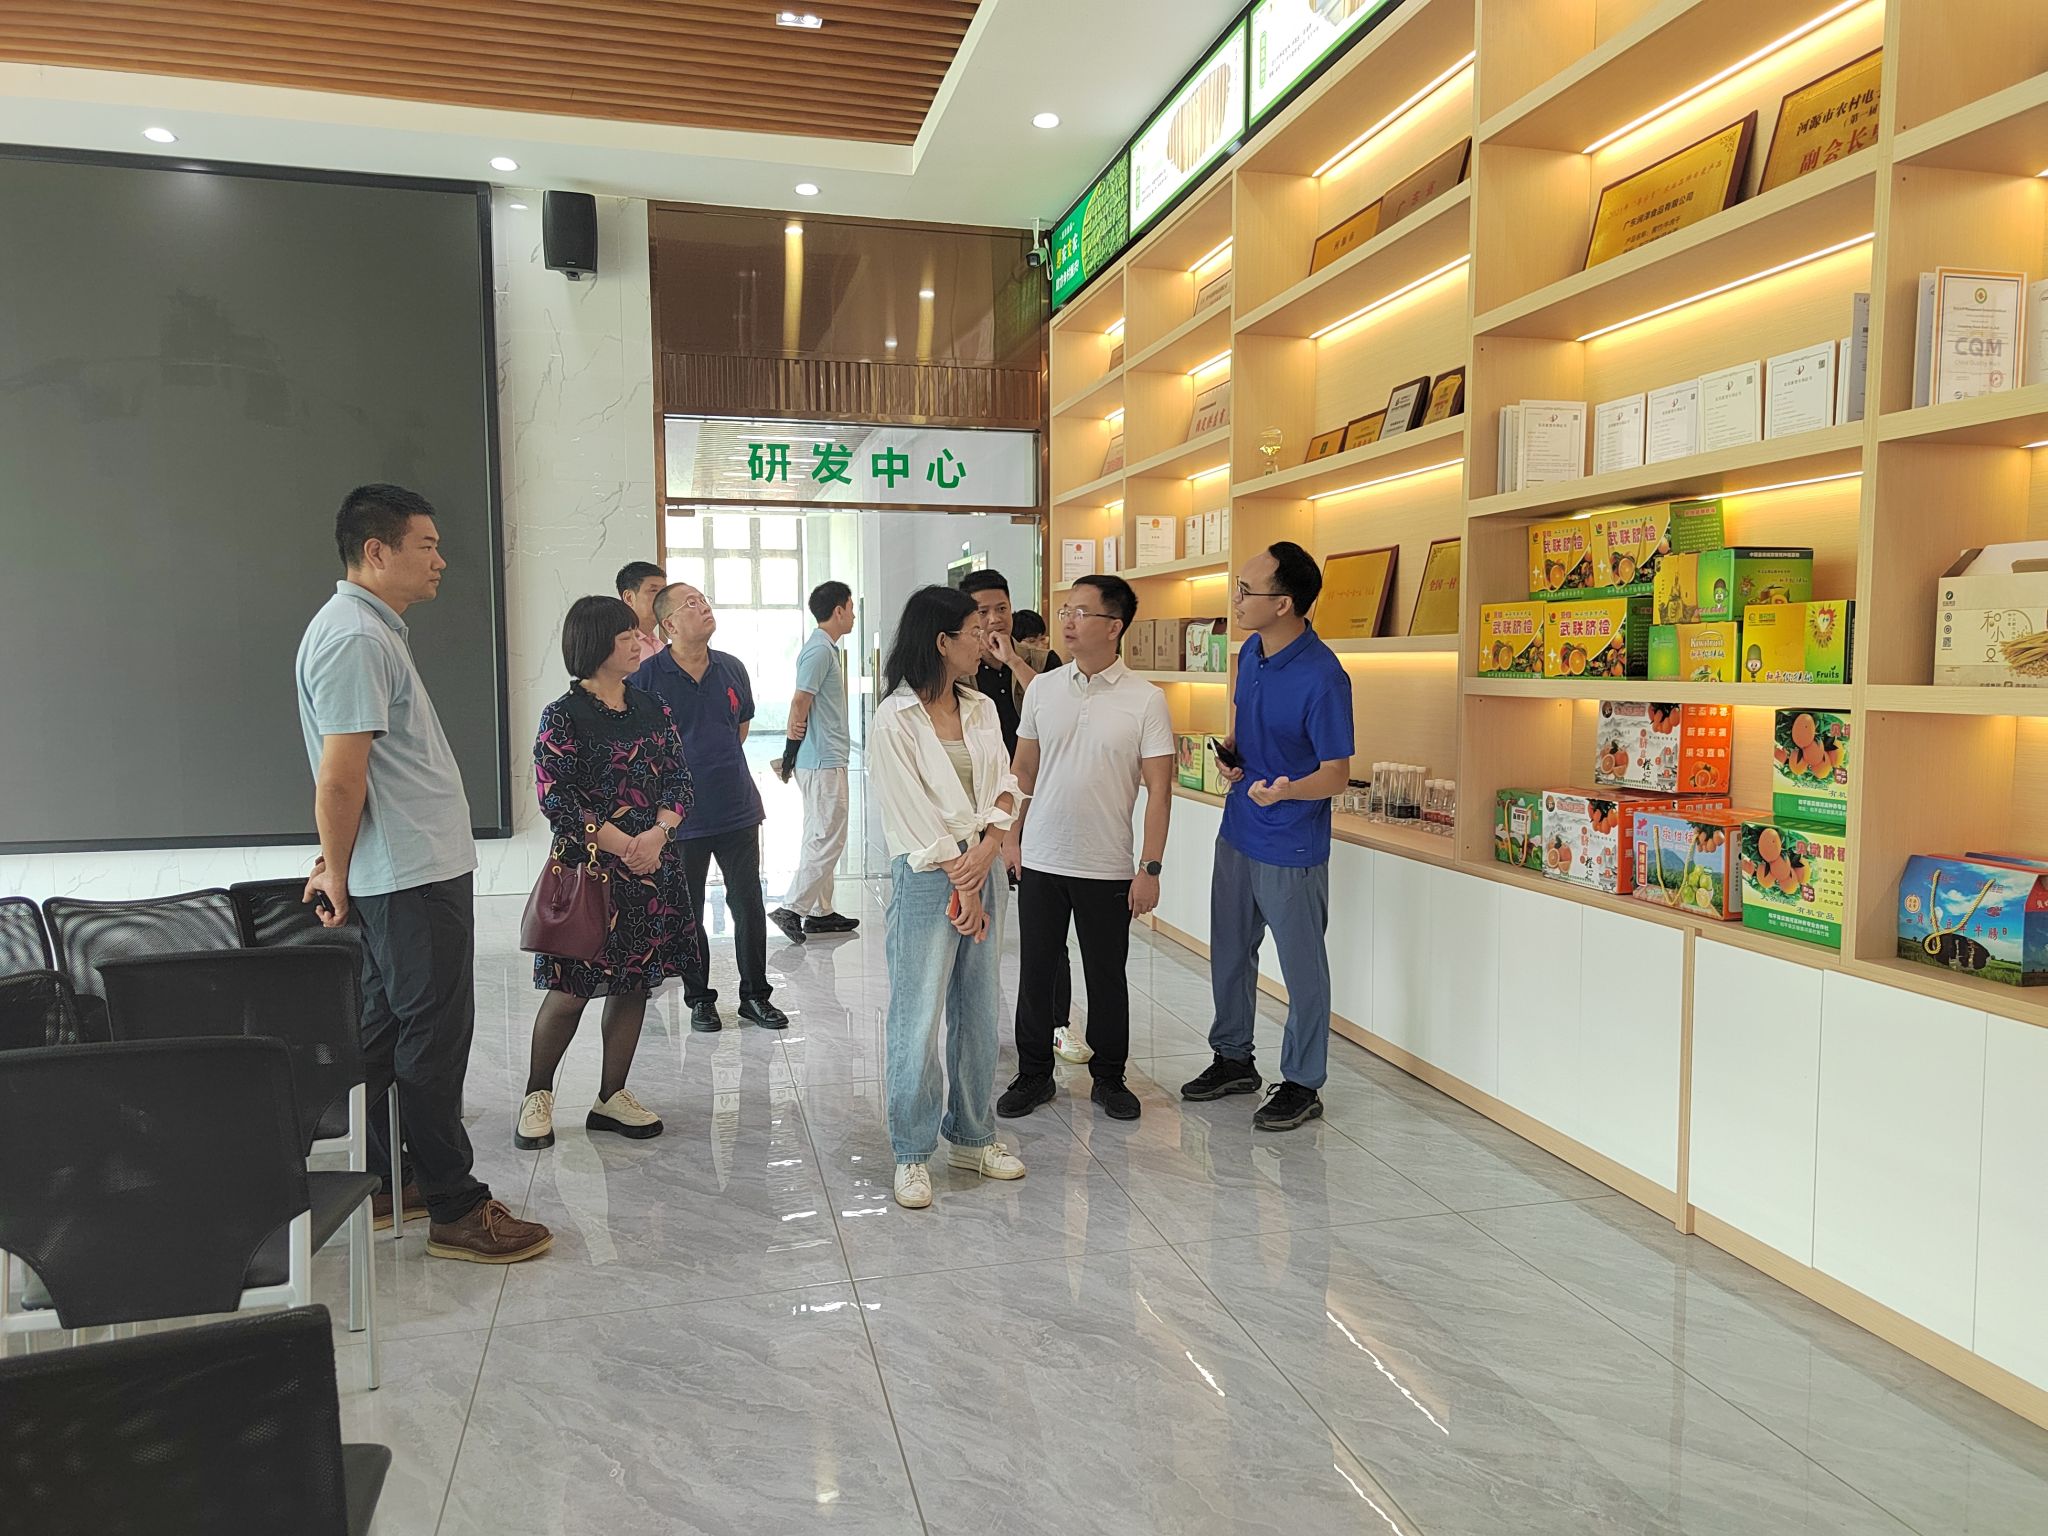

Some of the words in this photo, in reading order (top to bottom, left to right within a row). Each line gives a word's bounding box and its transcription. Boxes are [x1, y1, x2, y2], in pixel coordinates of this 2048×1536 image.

[1796, 89, 1880, 137] 河源市农村电
[1955, 337, 2002, 358] CQM
[747, 443, 967, 489] 研发中心
[1559, 619, 1611, 637] 武联脐橙
[1816, 670, 1840, 680] Fruits
